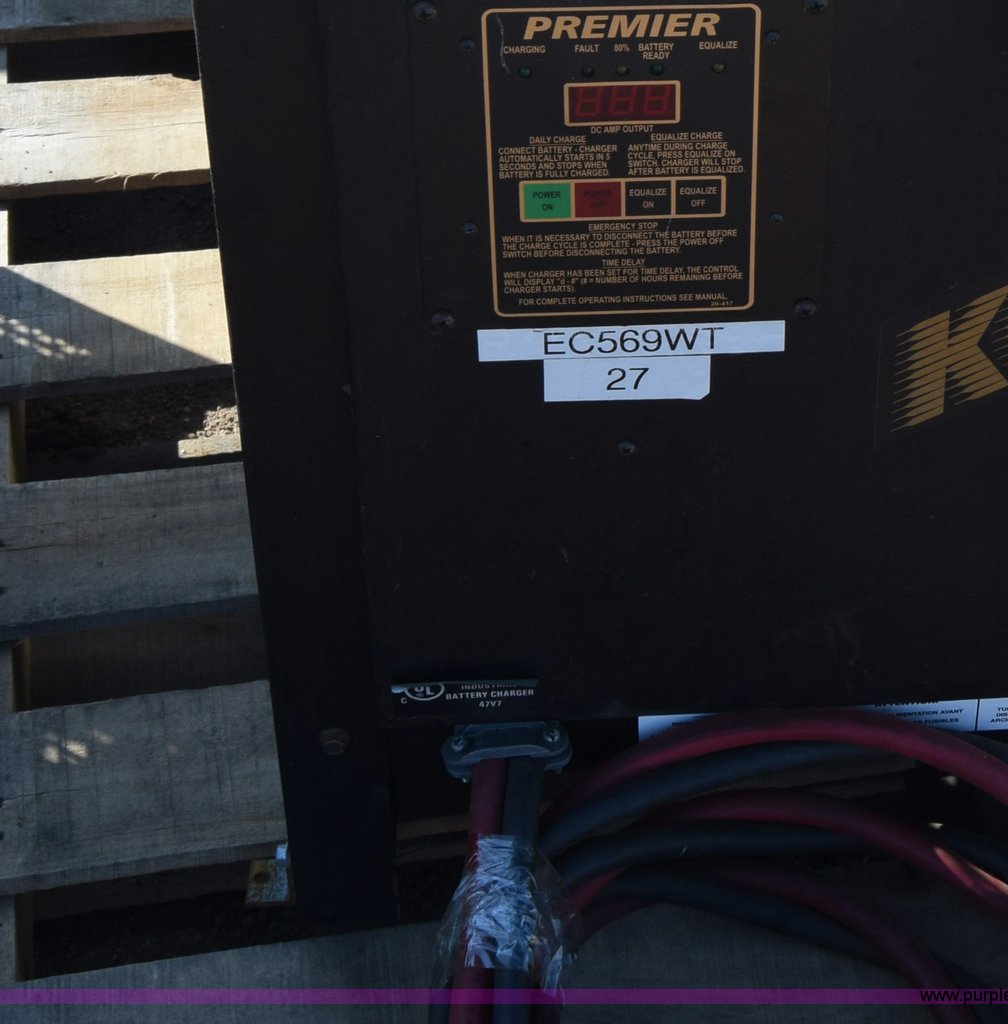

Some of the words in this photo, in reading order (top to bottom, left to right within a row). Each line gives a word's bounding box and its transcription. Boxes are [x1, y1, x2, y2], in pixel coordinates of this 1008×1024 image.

[523, 12, 721, 40] PREMIER
[503, 44, 546, 54] CHARGING
[574, 43, 600, 53] FAULT
[613, 43, 630, 52] 80%
[638, 42, 674, 51] BATTERY
[699, 40, 738, 50] EQUALIZE
[642, 51, 671, 60] READY
[590, 126, 602, 134] DC
[603, 125, 621, 133] AMP
[622, 124, 654, 133] OUTPUT
[529, 136, 552, 144] DAILY
[553, 135, 587, 143] CHARGE
[651, 132, 689, 141] EQUALIZE
[690, 131, 723, 140] CHARGE
[498, 146, 536, 155] CONNECT
[538, 145, 573, 154] BATTERY
[579, 144, 618, 153] CHARGER
[628, 143, 662, 152] ANYTIME
[663, 142, 693, 151] DURING
[695, 141, 728, 150] CHARGE
[499, 154, 563, 163] AUTOMATICALLY
[565, 153, 594, 161] STARTS
[596, 153, 604, 161] IN
[657, 151, 683, 159] PRESS
[684, 150, 722, 158] EQUALIZE
[724, 149, 736, 157] ON
[499, 162, 537, 171] SECONDS
[538, 162, 555, 170] AND
[557, 161, 583, 169] STOPS
[584, 161, 608, 169] WHEN
[661, 158, 699, 167] CHARGER
[701, 158, 719, 166] WILL
[721, 157, 742, 166] STOP
[499, 170, 534, 179] BATTERY
[536, 170, 543, 178] IS
[545, 170, 569, 178] FULLY
[628, 167, 653, 176] AFTER
[655, 166, 690, 175] BATTERY
[691, 166, 699, 174] IS
[532, 190, 561, 199] POWER
[629, 187, 668, 197] EQUALIZE
[679, 186, 718, 195] EQUALIZE
[642, 200, 655, 209] ON
[690, 199, 706, 208] OFF
[588, 223, 637, 231] EMERGENCY
[638, 222, 658, 230] STOP
[502, 235, 525, 243] WHEN
[535, 234, 543, 242] IS
[544, 233, 590, 242] NECESSARY
[592, 233, 602, 241] TO
[604, 232, 652, 240] DISCONNECT
[655, 231, 670, 239] THE
[671, 230, 705, 239] BATTERY
[707, 229, 738, 238] BEFORE
[502, 243, 518, 251] THE
[519, 242, 551, 250] CHARGE
[580, 241, 587, 249] IS
[589, 240, 630, 248] COMPLETE
[636, 239, 661, 247] PRESS
[663, 238, 678, 246] THE
[679, 238, 707, 246] POWER
[709, 237, 724, 245] OFF
[502, 251, 532, 259] SWITCH
[533, 250, 565, 258] BEFORE
[566, 248, 628, 257] DISCONNECTING
[630, 247, 645, 255] THE
[621, 258, 646, 266] DELAY
[503, 271, 527, 279] WHEN
[528, 270, 565, 278] CHARGER
[567, 269, 583, 277] HAS
[584, 269, 605, 277] BEEN
[606, 268, 621, 276] SET
[623, 268, 638, 276] FOR
[640, 267, 657, 275] TIME
[687, 266, 701, 274] THE
[703, 265, 739, 273] CONTROL
[503, 279, 522, 287] WILL
[524, 278, 555, 286] DISPLAY
[595, 275, 627, 284] NUMBER
[629, 275, 639, 283] OF
[641, 274, 668, 283] HOURS
[669, 273, 711, 282] REMAINING
[712, 272, 743, 281] BEFORE
[503, 286, 541, 294] CHARGER
[518, 298, 534, 306] FOR
[536, 297, 577, 305] COMPLETE
[578, 295, 621, 304] OPERATING
[623, 294, 677, 303] INSTRUCTIONS
[678, 293, 694, 302] SEE
[543, 326, 724, 356] EC569WT
[606, 367, 650, 391] 27
[446, 691, 487, 700] BATTERY
[490, 689, 534, 698] CHARGER
